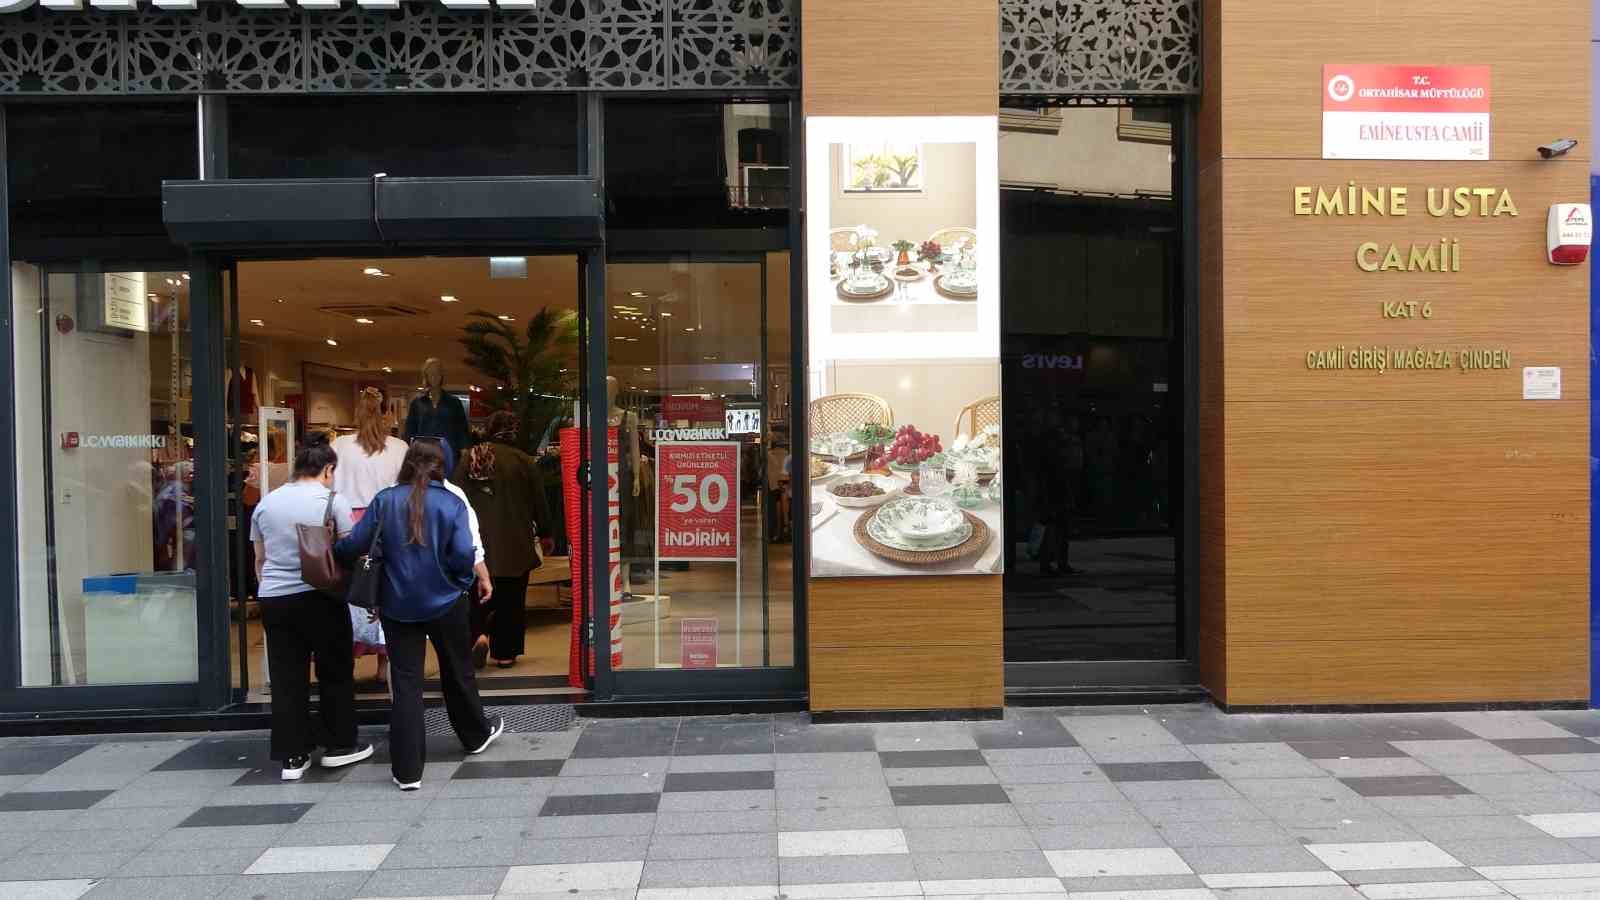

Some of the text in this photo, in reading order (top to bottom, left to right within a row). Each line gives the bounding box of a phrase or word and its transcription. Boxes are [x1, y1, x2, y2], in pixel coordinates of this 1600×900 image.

[1358, 87, 1419, 98] ORTAHİSAR
[1359, 120, 1483, 142] EMİNE USTA CAMİİ
[1294, 180, 1518, 217] EMİNE USTA
[1356, 238, 1461, 272] CAMİİ
[1383, 301, 1433, 318] KAT 6
[1306, 346, 1345, 369] CAMİİ
[1394, 344, 1452, 369] MAĞAZA
[665, 527, 731, 546] İNDİRİM
